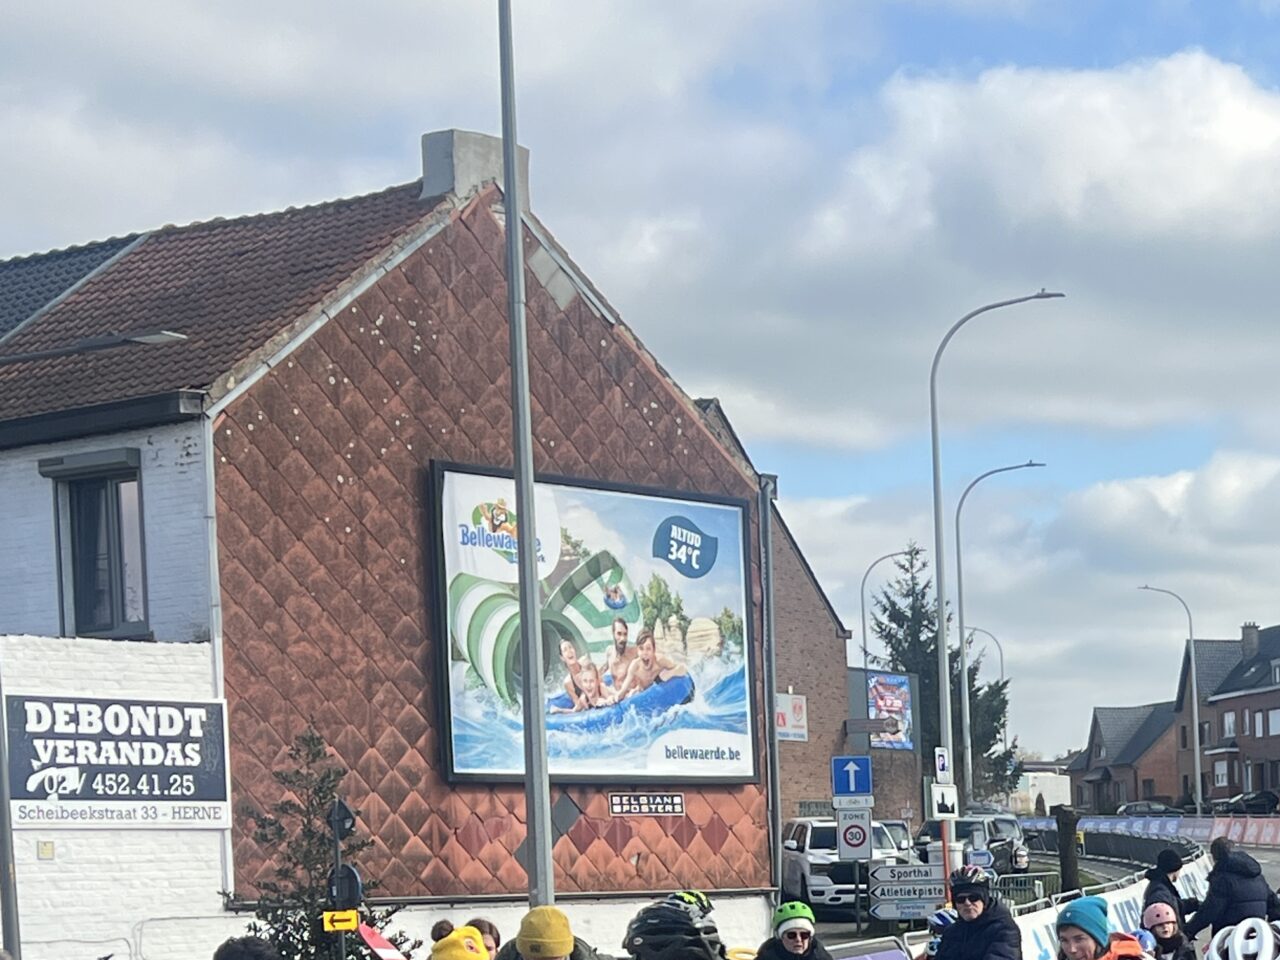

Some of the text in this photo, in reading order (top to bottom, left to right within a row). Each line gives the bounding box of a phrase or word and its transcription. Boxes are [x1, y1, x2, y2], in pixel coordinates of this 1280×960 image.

[24, 701, 207, 738] DEBONDT
[33, 738, 202, 767] VERANDAS
[665, 744, 741, 762] bellewaerde.be
[92, 773, 196, 796] 452.41.25
[612, 796, 673, 805] BELGIAN
[18, 805, 137, 821] Scheibeekstraat
[140, 806, 158, 820] 33
[171, 806, 222, 821] HERNE
[622, 804, 682, 813] POSTERS
[843, 813, 866, 821] ZONE
[848, 831, 862, 841] 30
[889, 868, 933, 881] Sporthal
[879, 887, 944, 899] Atletiekpiste
